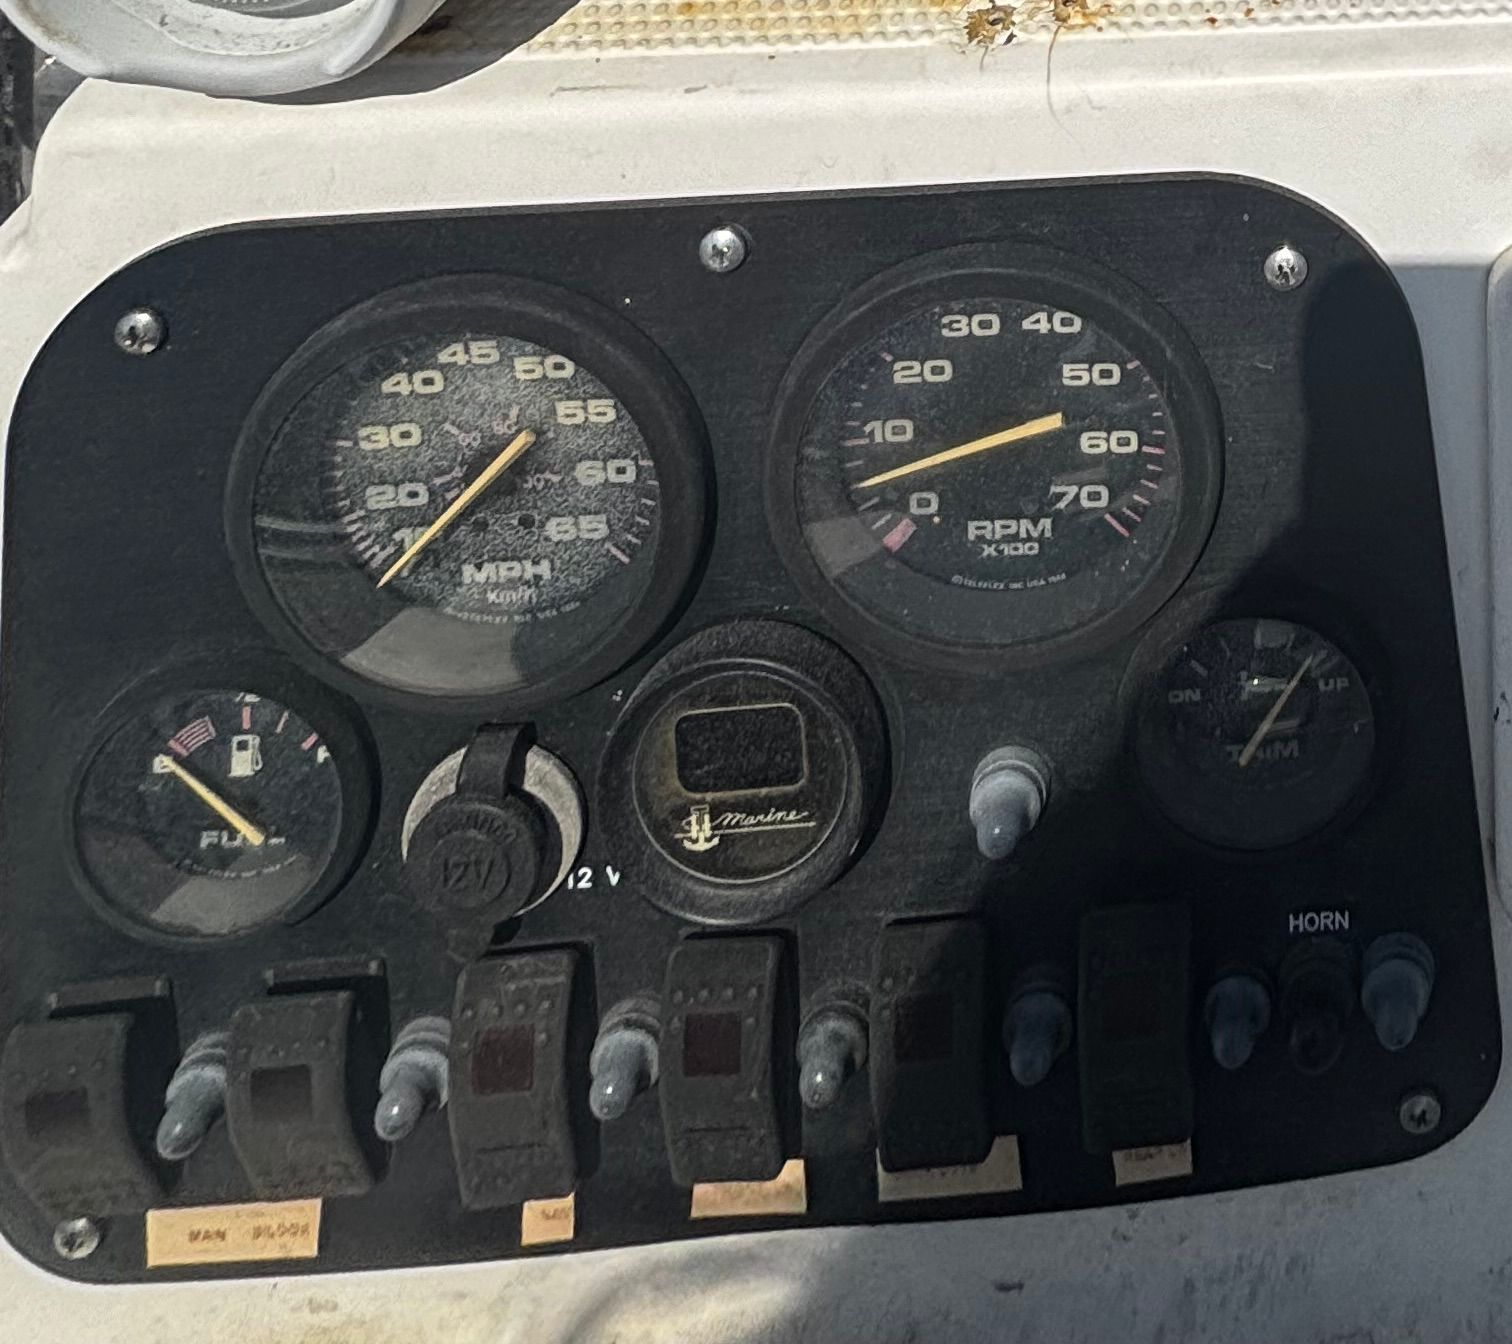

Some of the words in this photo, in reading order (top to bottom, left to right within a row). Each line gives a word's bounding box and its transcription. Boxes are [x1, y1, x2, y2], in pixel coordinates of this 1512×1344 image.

[940, 313, 1000, 337] 30
[1021, 311, 1082, 334] 40
[437, 340, 501, 366] 45
[513, 355, 575, 380] 50
[892, 359, 953, 384] 20
[1062, 362, 1121, 387] 50
[381, 370, 445, 396] 40
[555, 398, 617, 425] 55
[357, 422, 422, 452] 30
[863, 419, 915, 444] 10
[1079, 430, 1138, 455] 60
[575, 459, 637, 486] 60
[364, 482, 430, 511] 20
[909, 491, 940, 515] 0
[1048, 483, 1110, 510] 70
[545, 514, 609, 542] 65
[968, 518, 1053, 541] RPM
[461, 559, 551, 584] MPH
[1318, 677, 1350, 692] UP
[1226, 739, 1299, 761] TIM
[567, 866, 593, 890] 12
[1289, 910, 1349, 933] HORN
